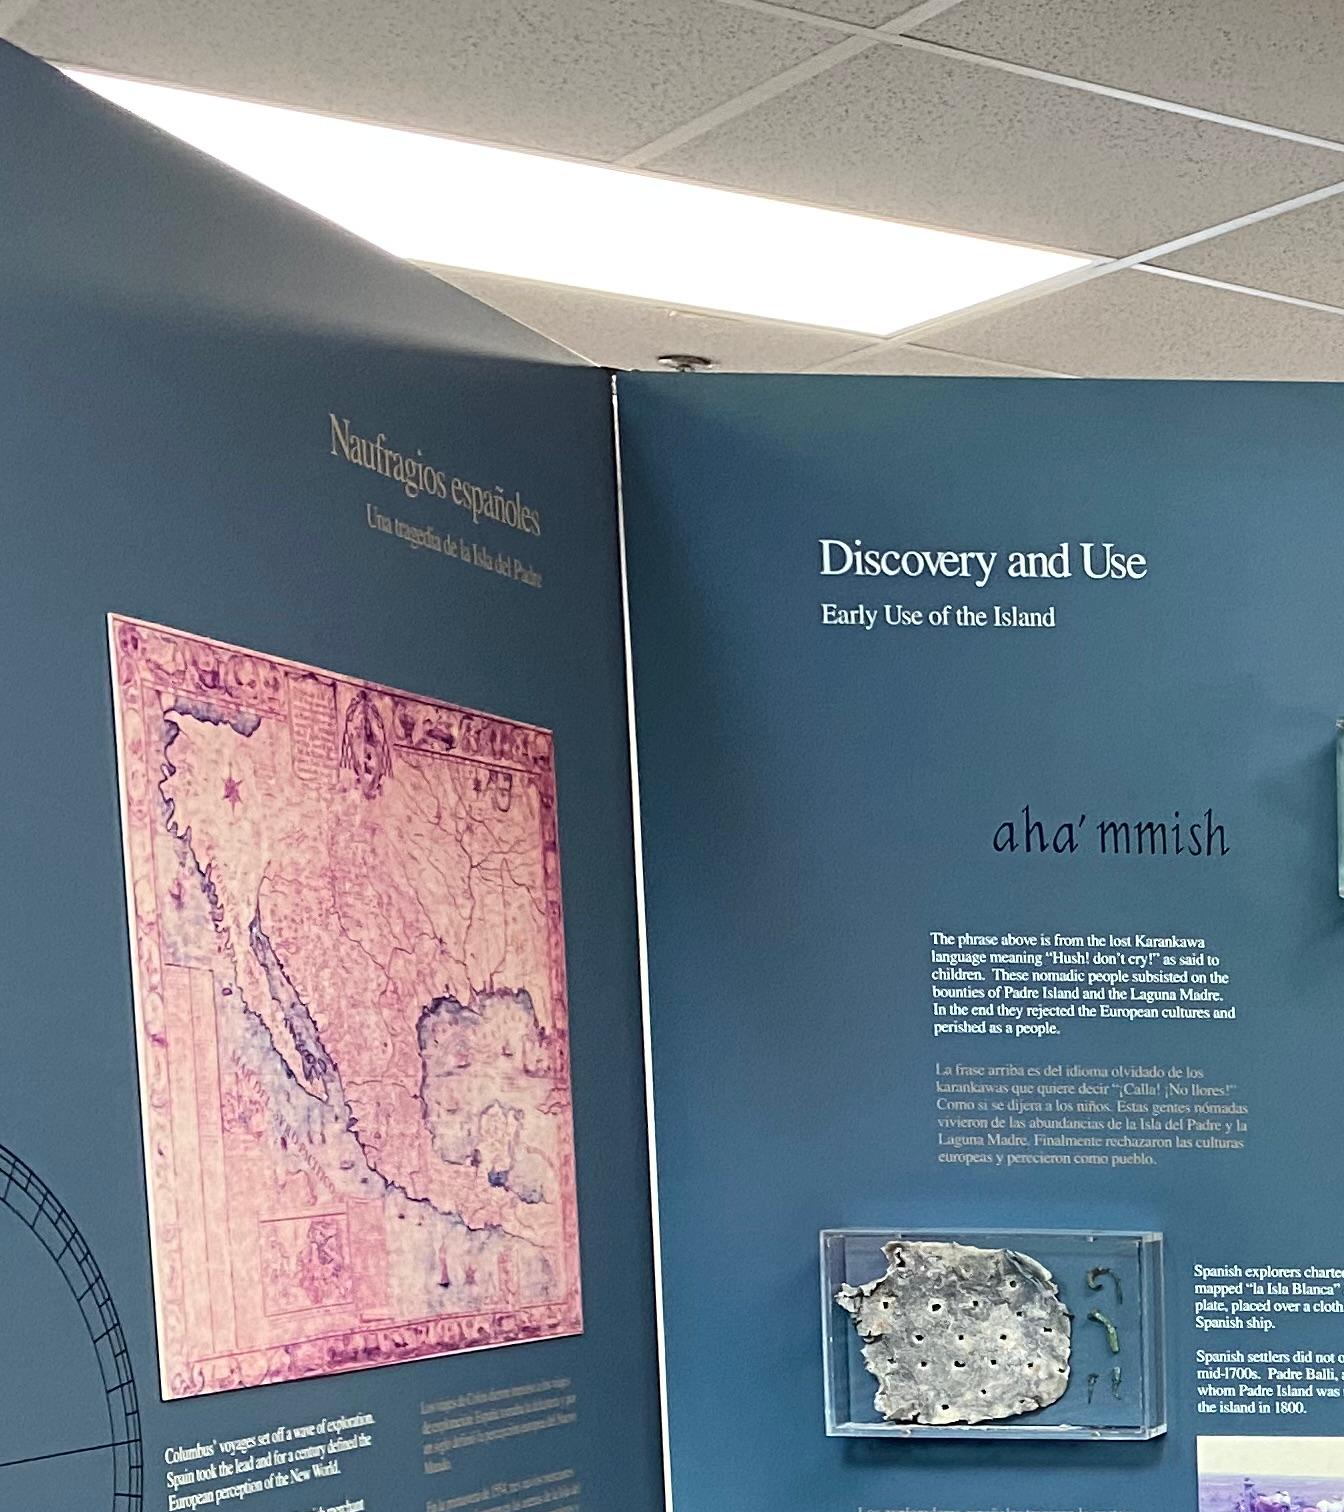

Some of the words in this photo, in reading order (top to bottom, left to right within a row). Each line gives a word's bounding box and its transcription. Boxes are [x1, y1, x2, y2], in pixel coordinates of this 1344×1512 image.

[329, 414, 446, 498] Naufragios
[452, 478, 540, 536] españoles
[819, 540, 997, 587] Discovery
[1008, 543, 1072, 578] and
[1080, 543, 1147, 578] Use
[821, 604, 877, 630] Early
[884, 605, 923, 625] Use
[929, 605, 952, 625] of
[956, 606, 987, 626] the
[994, 606, 1055, 627] Island
[930, 932, 955, 944] The
[958, 933, 998, 948] phrase
[1001, 933, 1037, 945] above
[1041, 934, 1051, 946] is
[1055, 934, 1084, 946] from
[1087, 935, 1106, 946] the
[1110, 935, 1131, 947] lost
[1136, 935, 1205, 948] Karankawa
[932, 951, 986, 966] language
[990, 951, 1042, 966] meaning
[1163, 956, 1176, 965] as
[1179, 953, 1204, 965] said
[1207, 956, 1219, 966] to
[1194, 1265, 1242, 1280] Spanish
[1245, 1266, 1301, 1280] explorers
[219, 1437, 256, 1455] voyages
[258, 1433, 270, 1446] set
[272, 1427, 285, 1443] off
[286, 1430, 292, 1440] a
[293, 1425, 315, 1438] wave
[316, 1420, 326, 1434] of
[327, 1414, 375, 1434] exploration.
